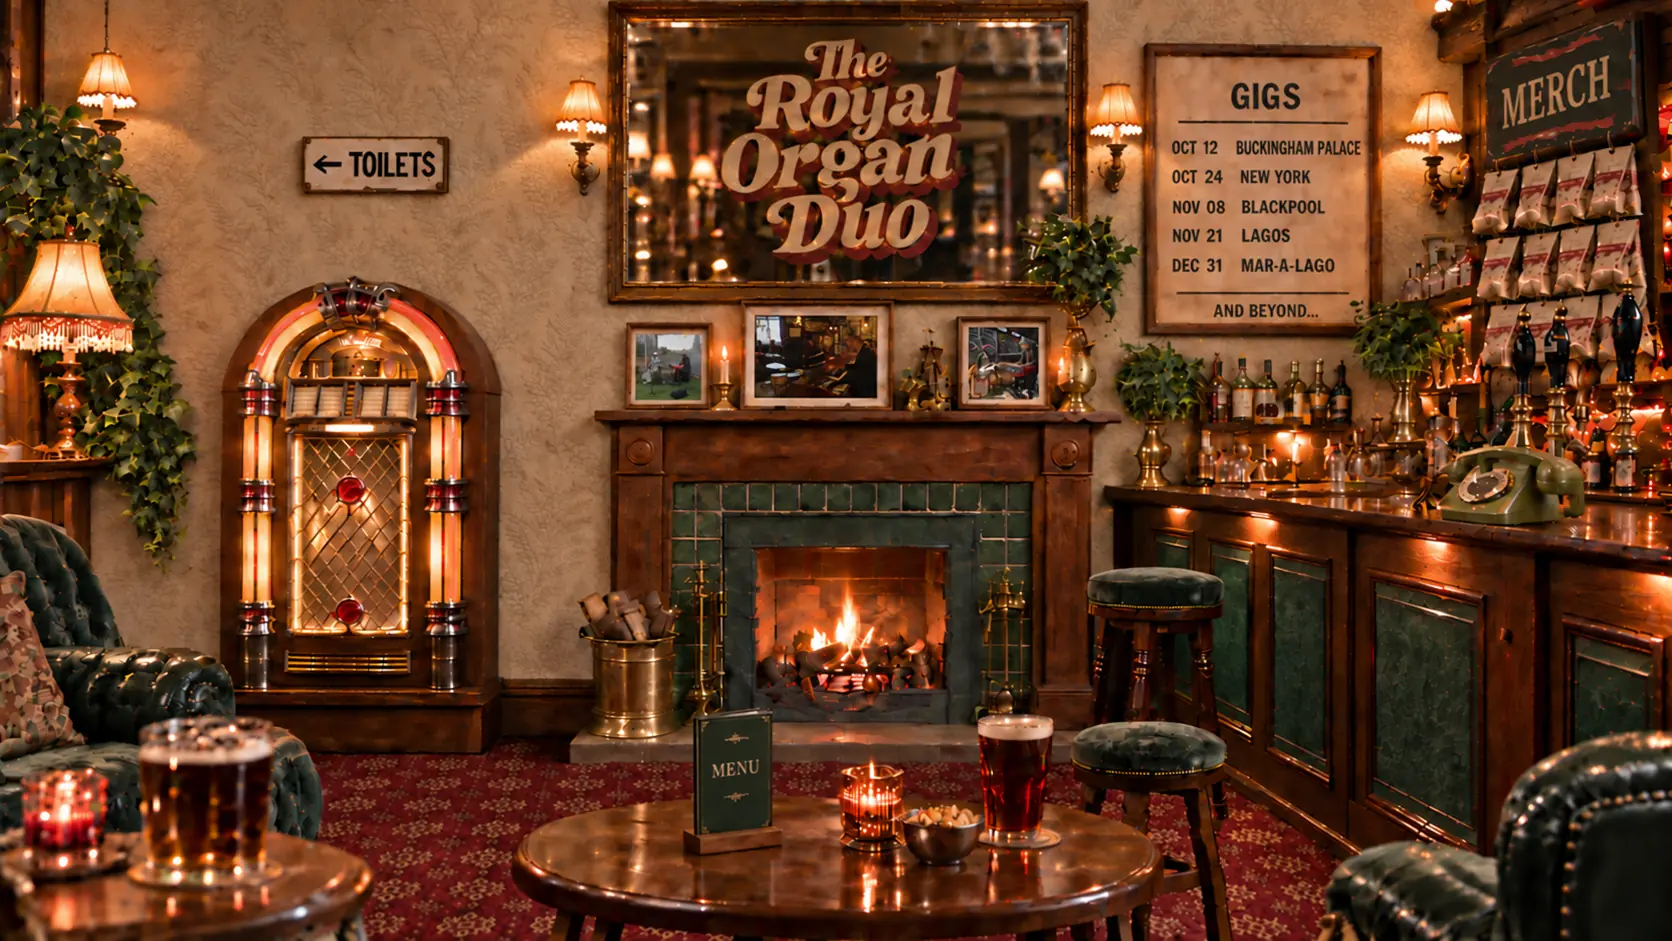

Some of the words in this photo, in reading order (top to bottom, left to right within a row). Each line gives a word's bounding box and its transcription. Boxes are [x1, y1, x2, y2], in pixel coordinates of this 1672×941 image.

[804, 38, 889, 82] The
[746, 65, 957, 142] Royal
[1230, 82, 1301, 110] GIGS
[1501, 55, 1612, 130] MERCH
[1171, 140, 1198, 155] OCT
[1203, 140, 1218, 155] 12
[1236, 140, 1314, 156] BUCKINGHAM
[1317, 140, 1361, 156] PALACE
[348, 151, 436, 178] TOILETS
[721, 132, 955, 203] Organ
[1171, 169, 1198, 184] OCT
[1204, 169, 1223, 184] 24
[1240, 169, 1270, 184] NEW
[1274, 169, 1311, 184] YORK
[1172, 200, 1200, 215] NOV
[1206, 200, 1226, 215] 08
[1241, 200, 1326, 215] BLACKPOOL
[766, 194, 931, 254] Duo
[1172, 228, 1200, 243] NOV
[1206, 228, 1223, 243] 21
[1241, 228, 1291, 243] LAGOS
[1172, 258, 1200, 273] DEC
[1206, 258, 1223, 273] 31
[1241, 258, 1336, 273] MAR-A-LAGO
[1213, 303, 1245, 318] AND
[1249, 303, 1319, 319] BEYOND...
[711, 758, 760, 779] MENU
